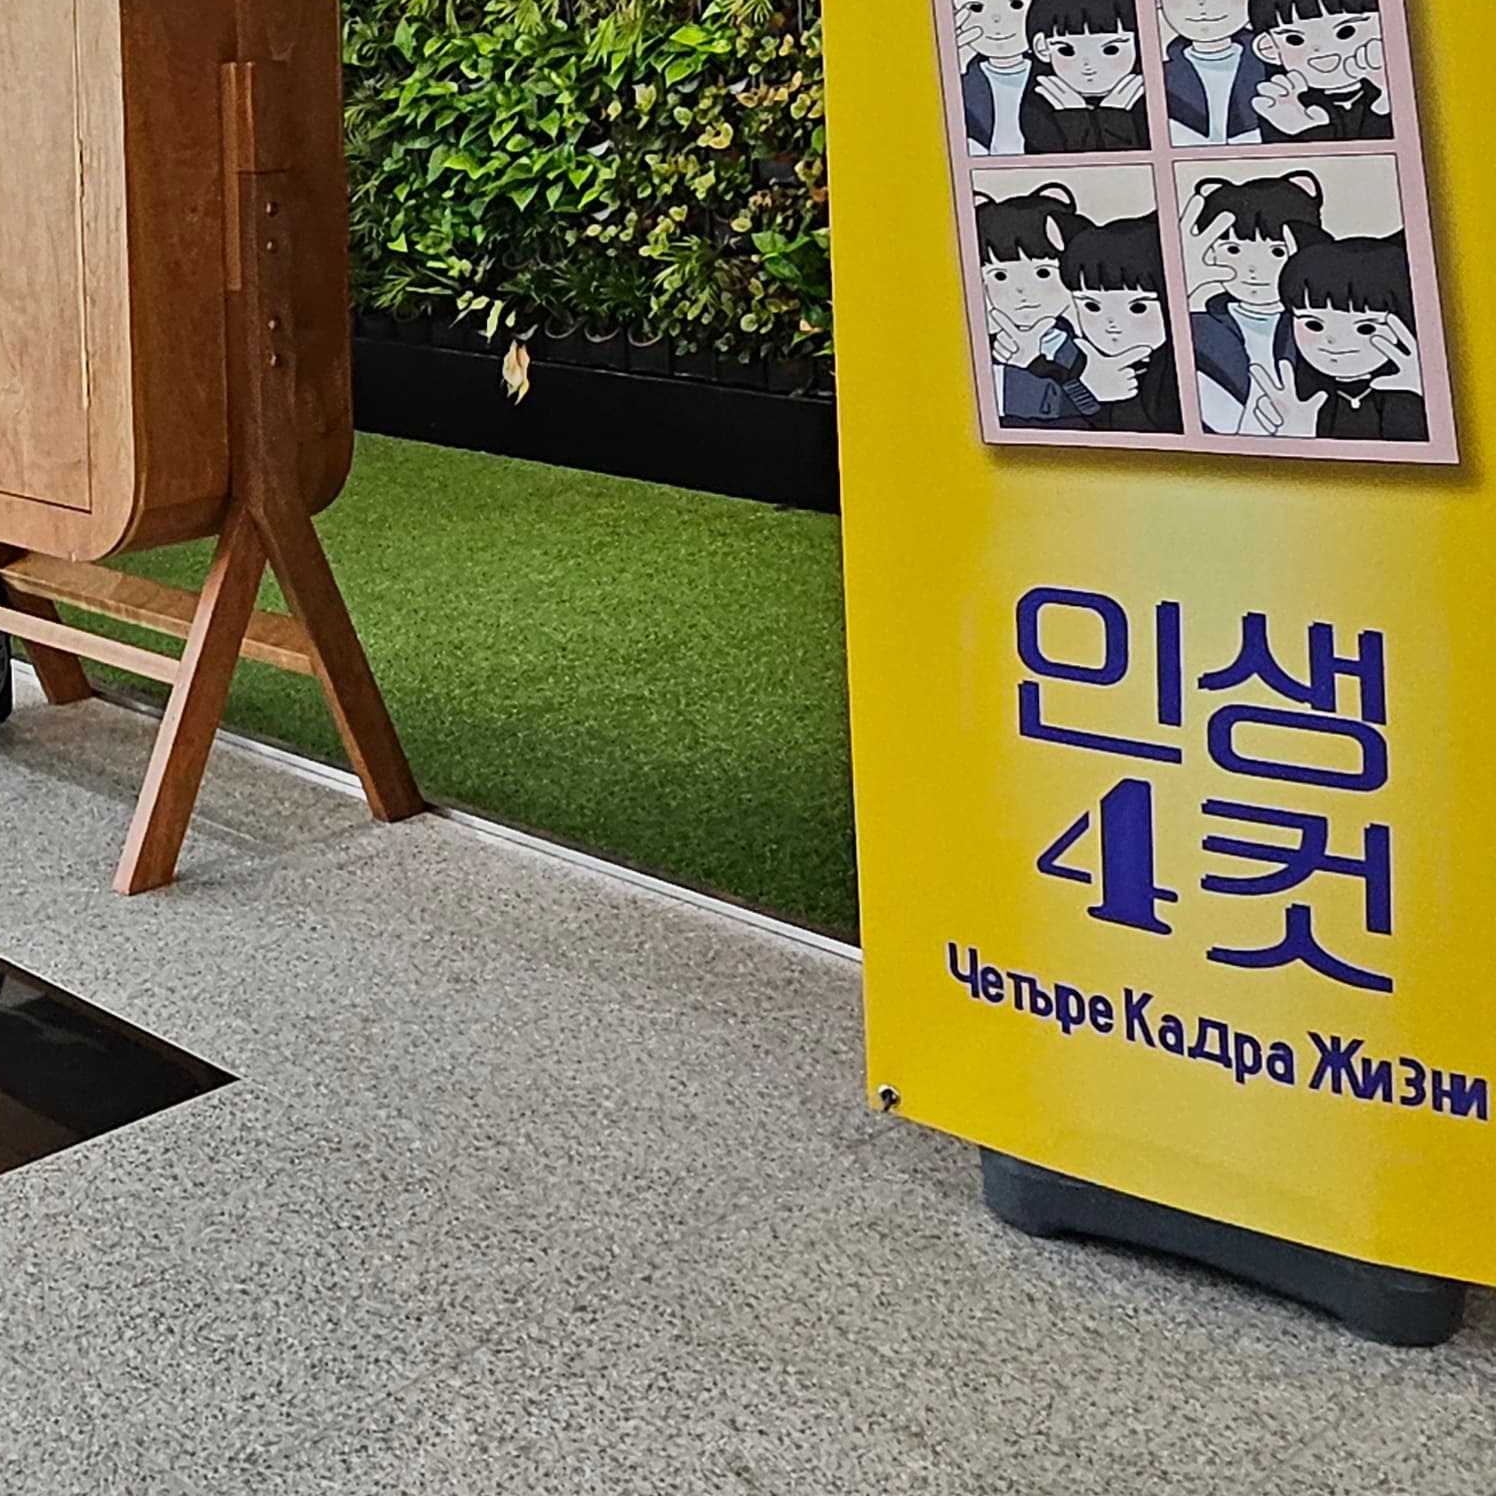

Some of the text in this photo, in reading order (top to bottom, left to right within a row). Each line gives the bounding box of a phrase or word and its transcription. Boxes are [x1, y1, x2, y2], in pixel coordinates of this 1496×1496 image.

[1016, 586, 1389, 793] 인생
[1036, 778, 1394, 993] 4컷
[947, 941, 1489, 1122] Четыре Кадра Жизни
